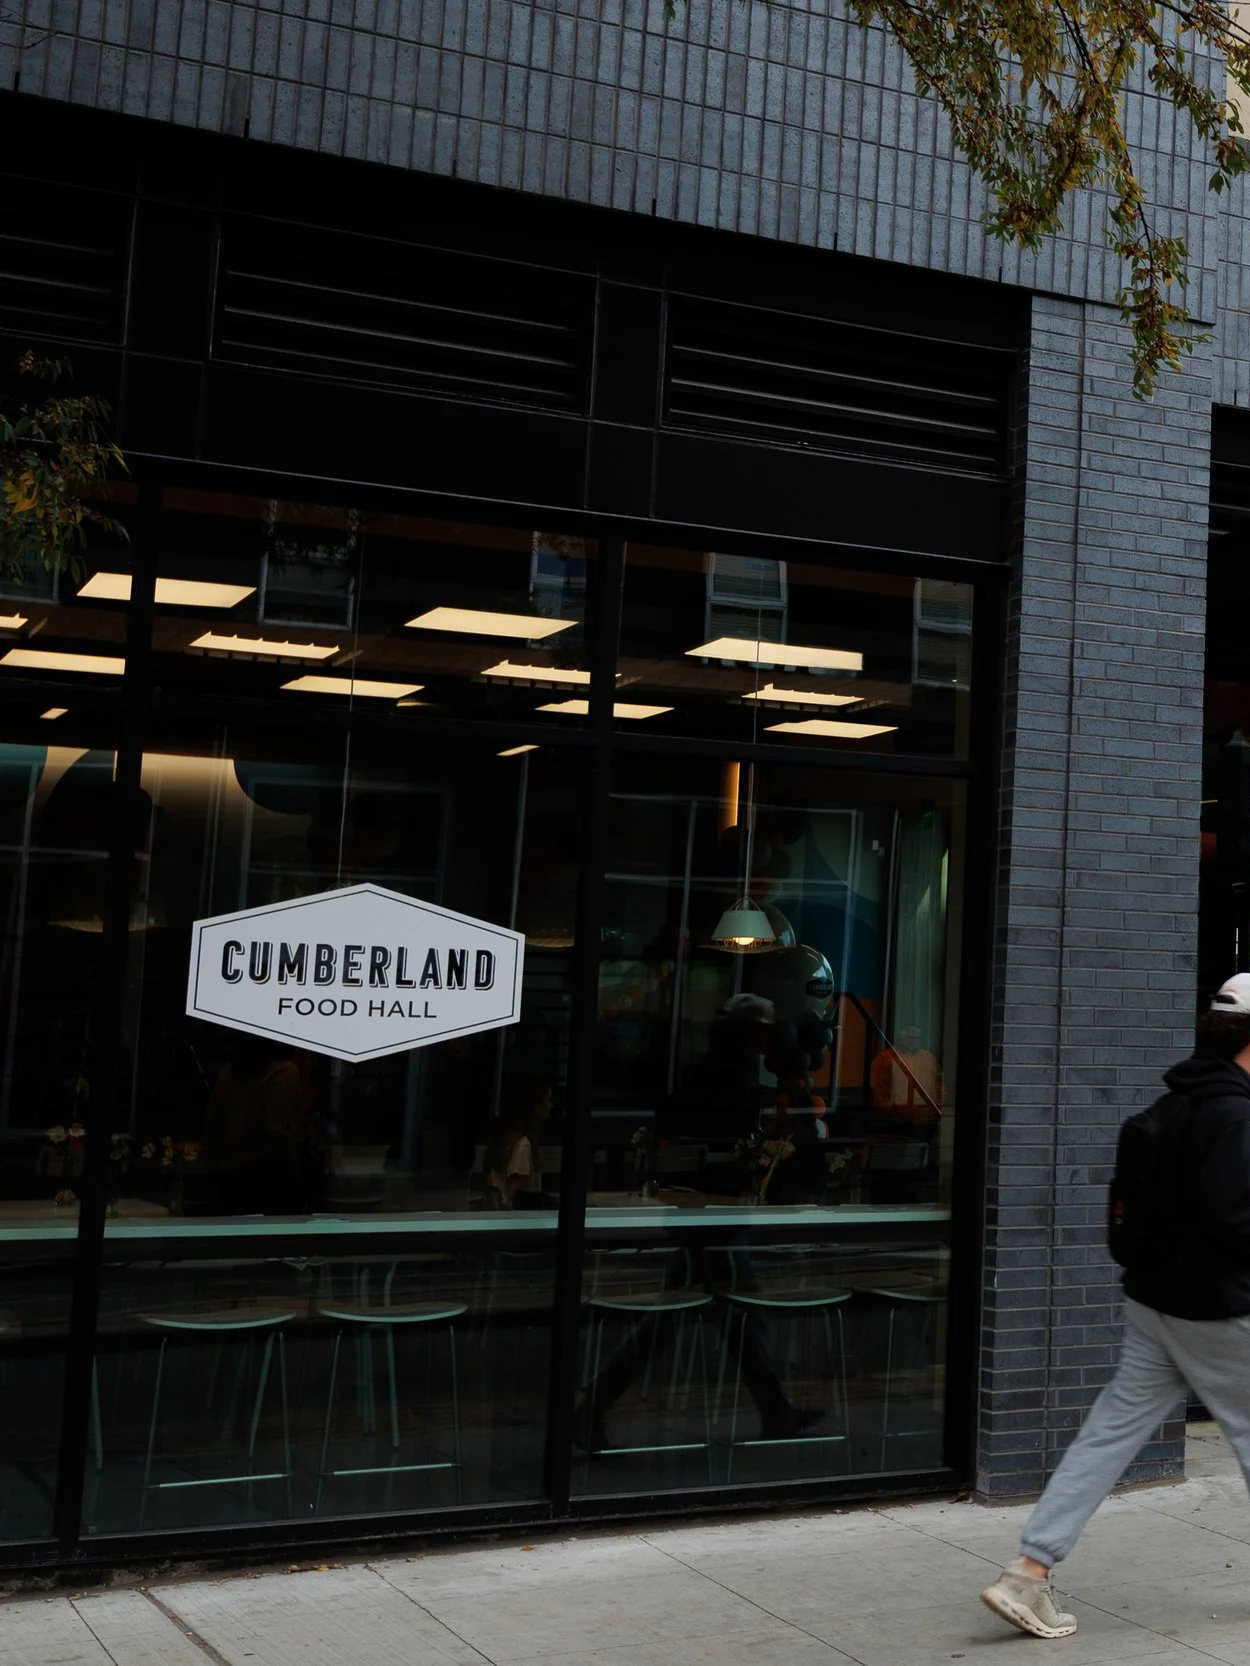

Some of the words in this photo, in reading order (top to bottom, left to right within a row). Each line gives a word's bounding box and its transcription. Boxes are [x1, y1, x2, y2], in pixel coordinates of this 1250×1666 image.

[221, 939, 497, 991] CUMBERLAND
[278, 998, 358, 1017] FOOD
[367, 1000, 437, 1019] HALL
